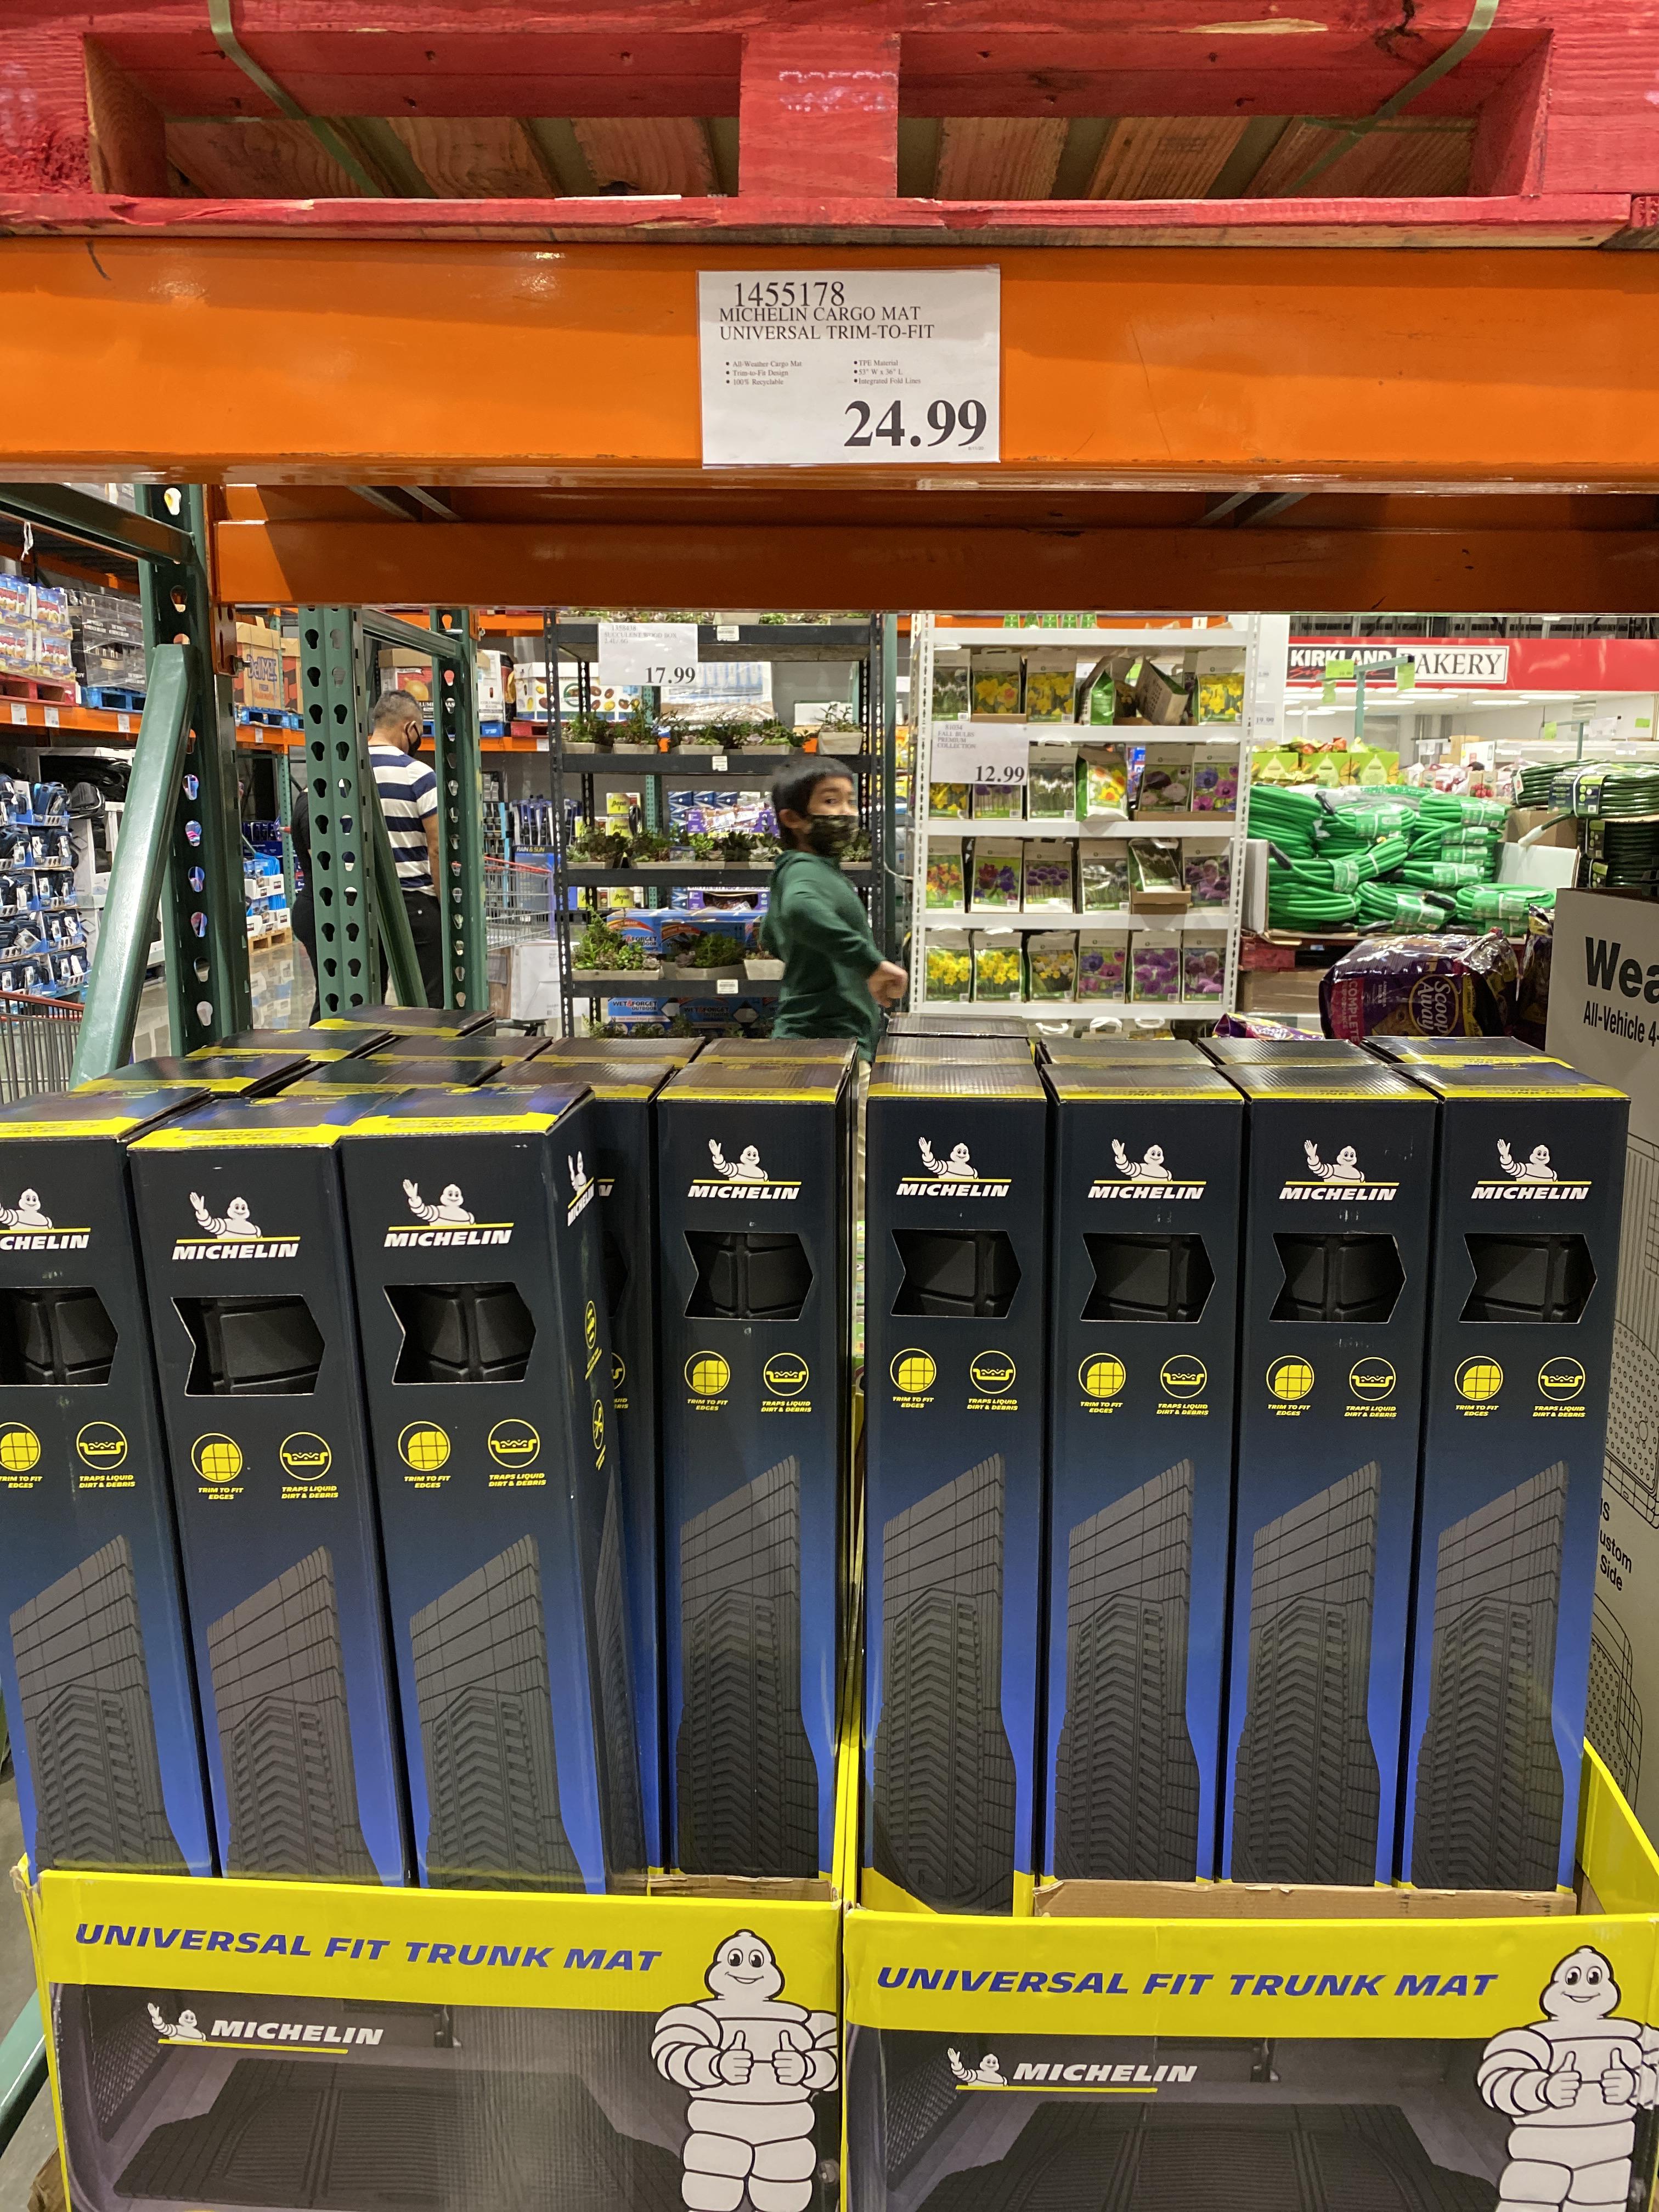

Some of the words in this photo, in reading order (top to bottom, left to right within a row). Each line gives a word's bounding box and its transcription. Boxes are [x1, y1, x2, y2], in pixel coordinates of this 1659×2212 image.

[735, 281, 845, 307] 1455178
[720, 307, 807, 322] MICHELIN
[814, 306, 876, 321] CARGO
[882, 306, 921, 320] MAT
[720, 325, 821, 340] UNIVERSAL
[826, 324, 935, 339] TRIM-TO-FIT
[844, 399, 987, 447] 24.99
[1401, 653, 1503, 675] AKERY
[645, 667, 696, 684] 17.99
[975, 765, 1025, 783] 12.99
[1585, 936, 1659, 1005] Wea
[1347, 979, 1360, 1043] COMPLETE
[1417, 981, 1434, 1031] Away
[1434, 980, 1452, 1034] Scoop
[1583, 1001, 1645, 1043] All-Vehicle
[688, 1185, 800, 1200] MICHELIN
[896, 1183, 1009, 1197] MICHELIN
[1088, 1185, 1205, 1200] MICHELIN
[1279, 1186, 1397, 1200] MICHELIN
[1471, 1186, 1589, 1200] MICHELIN
[0, 1234, 89, 1250] CHELIN
[384, 1229, 512, 1248] MICHELIN
[172, 1243, 299, 1261] MICHELIN
[1600, 1530, 1632, 1574] ustom
[1600, 1554, 1623, 1592] Side
[76, 1923, 314, 1958] UNIVERSAL
[324, 1937, 393, 1961] FIT
[405, 1940, 556, 1969] TRUNK
[562, 1946, 662, 1972] MAT
[877, 1967, 1132, 1994] UNIVERSAL
[1140, 1973, 1214, 1996] FIT
[1228, 1974, 1389, 1997] TRUNK
[1393, 1974, 1498, 1997] MAT
[211, 2019, 384, 2046] MICHELIN
[1012, 2063, 1198, 2084] MICHELIN
